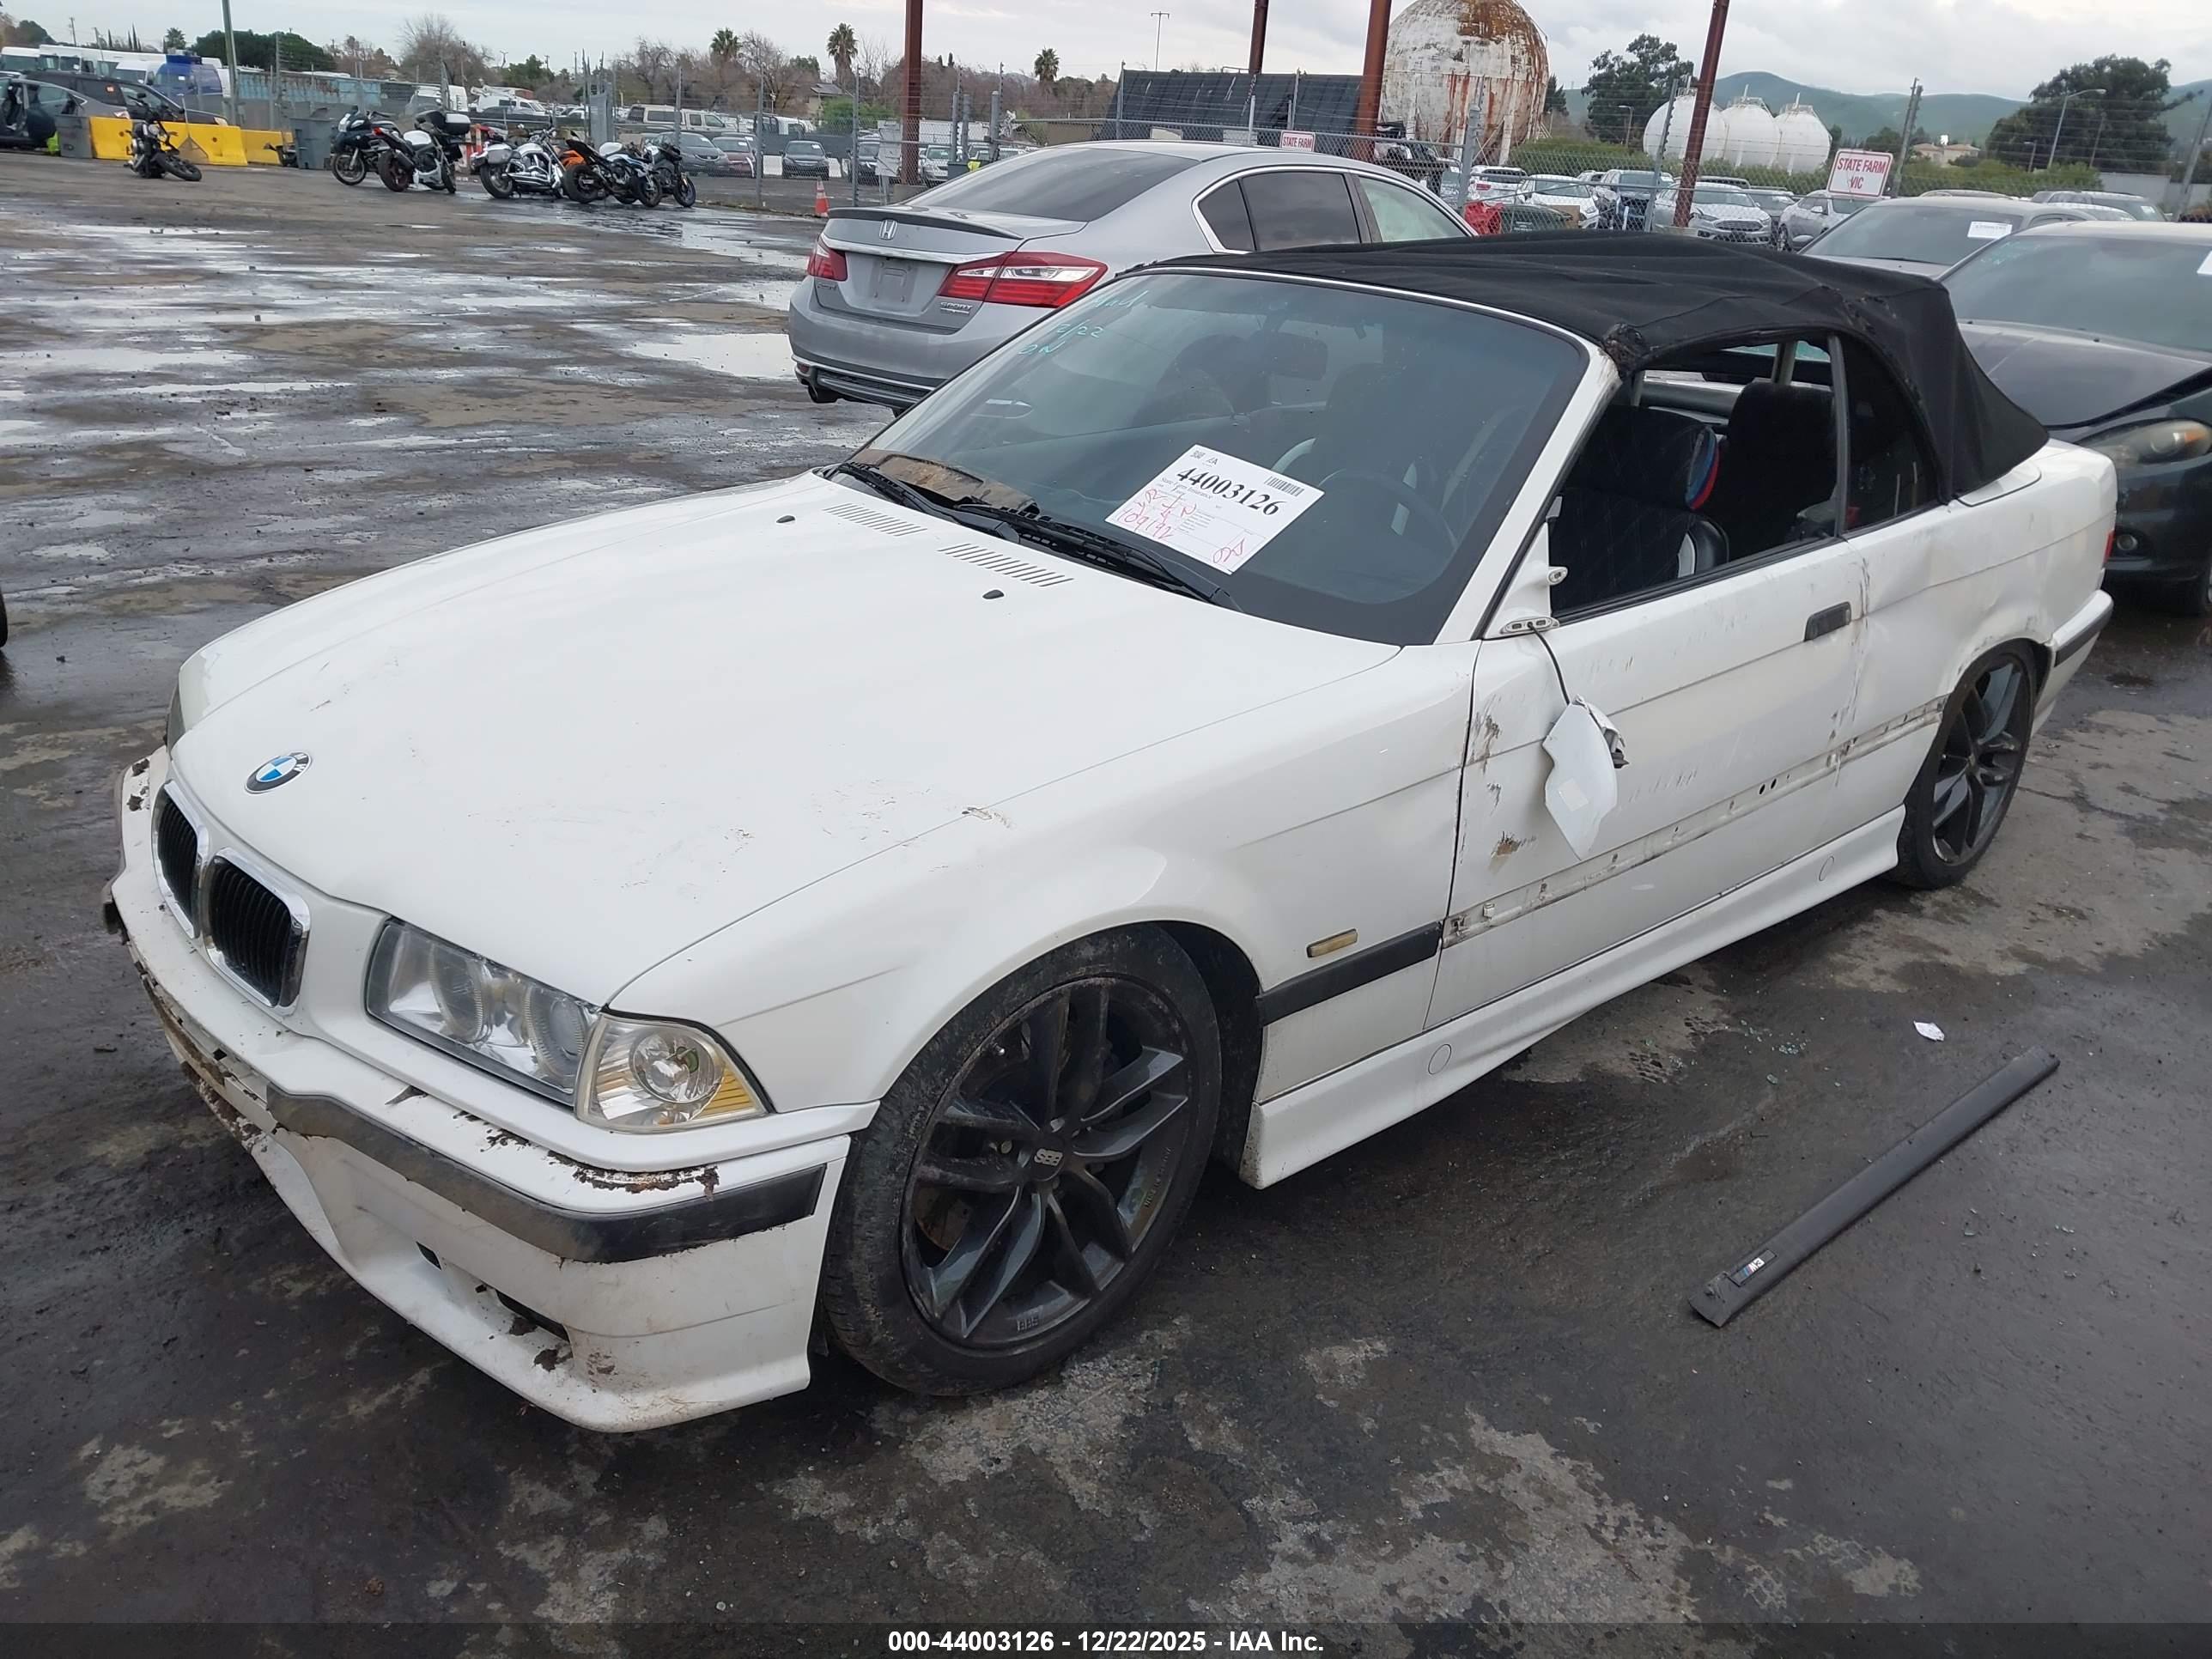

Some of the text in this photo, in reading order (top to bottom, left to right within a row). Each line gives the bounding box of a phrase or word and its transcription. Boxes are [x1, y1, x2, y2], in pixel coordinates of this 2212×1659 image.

[1283, 137, 1312, 148] STATE FARM
[1838, 158, 1887, 173] STATE FARM
[1850, 176, 1864, 189] VIC
[940, 301, 974, 311] SPORT
[1176, 467, 1287, 515] 44003126
